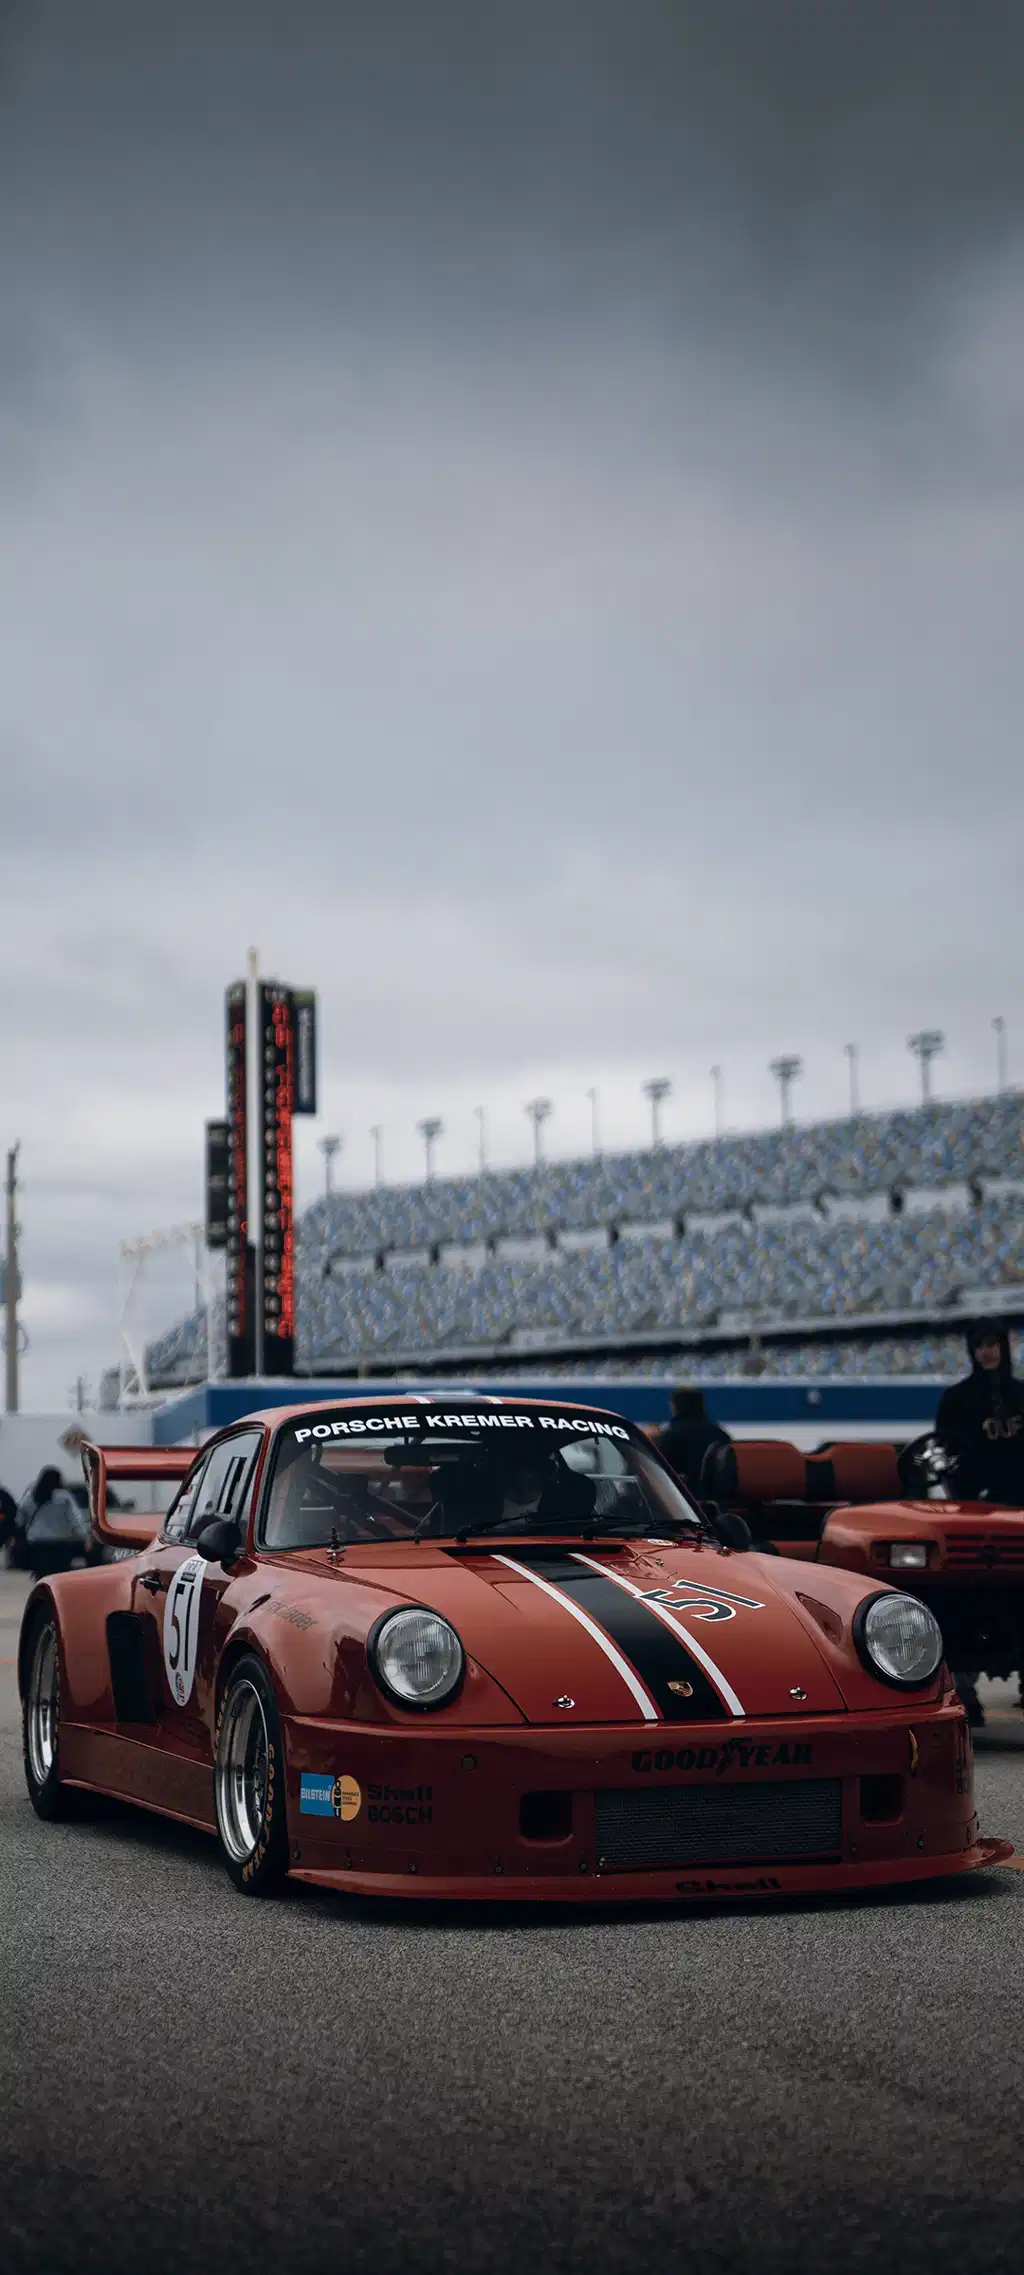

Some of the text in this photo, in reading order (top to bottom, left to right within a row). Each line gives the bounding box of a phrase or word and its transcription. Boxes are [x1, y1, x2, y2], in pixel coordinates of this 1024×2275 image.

[294, 1414, 630, 1443] PORSCHE KREMER RACING
[633, 1578, 766, 1622] 51
[168, 1582, 195, 1672] 51
[631, 1737, 813, 1775] GOODYEAR
[300, 1787, 331, 1801] BILSTEIN
[367, 1783, 434, 1802] Shell
[367, 1804, 434, 1824] BOSCH
